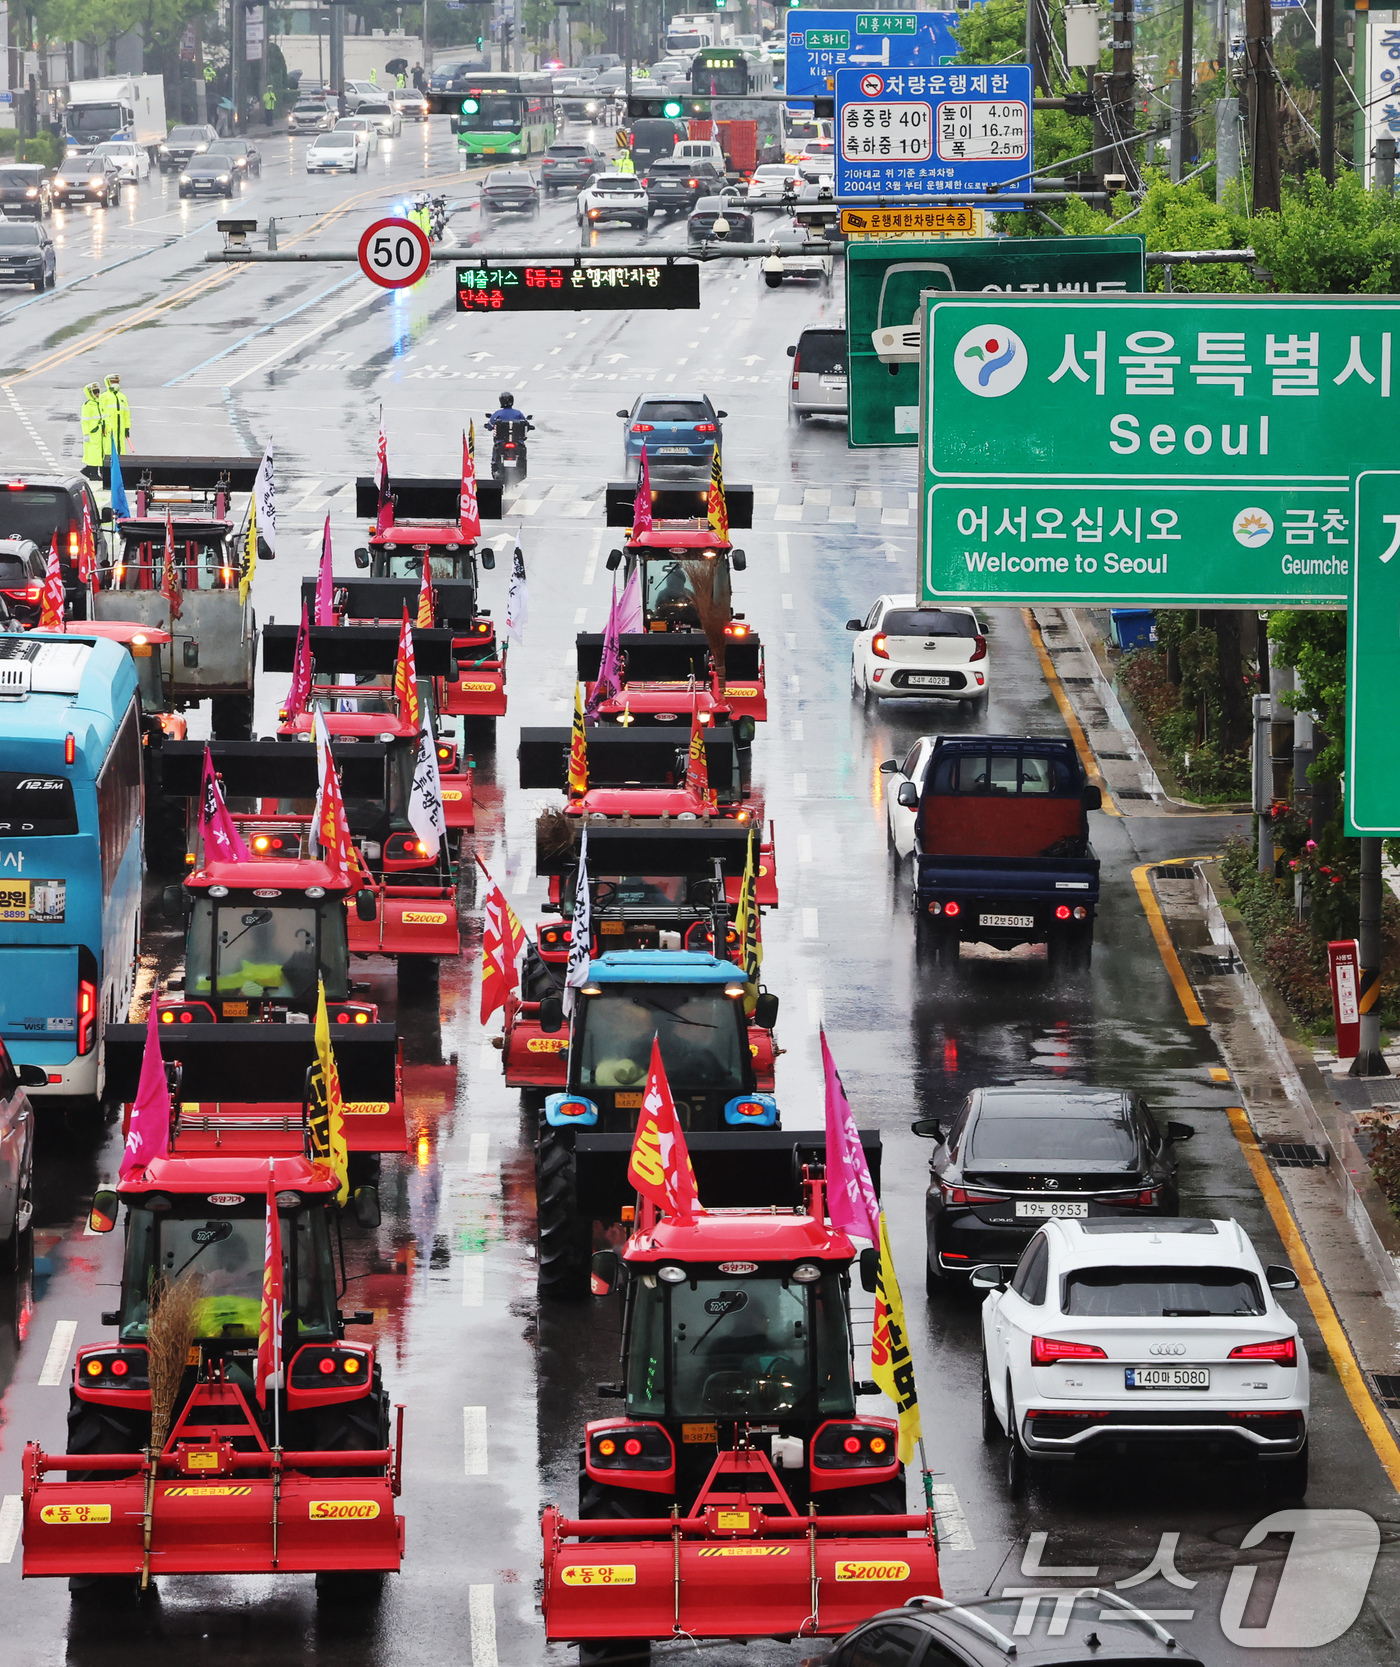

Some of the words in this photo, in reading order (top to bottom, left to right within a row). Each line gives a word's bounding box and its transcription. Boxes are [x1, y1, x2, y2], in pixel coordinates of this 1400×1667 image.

[858, 16, 916, 33] 시흥사거리
[809, 33, 847, 46] 소하IC
[807, 52, 848, 65] 기아로
[885, 73, 1010, 95] 차량운행제한
[846, 108, 893, 129] 총중량
[899, 111, 928, 128] 40t
[942, 104, 973, 121] 높이
[988, 105, 1023, 118] 4.0m
[942, 123, 973, 140] 길이
[981, 123, 1023, 137] 16.7m
[846, 136, 893, 155] 축하중
[899, 138, 928, 154] 10t
[951, 141, 967, 158] 폭
[990, 140, 1024, 155] 2.5m
[843, 169, 881, 179] 기아대교
[884, 168, 895, 179] 위
[897, 168, 916, 178] 기준
[918, 168, 956, 178] 초과차량
[843, 181, 882, 192] 2004년
[885, 181, 901, 191] 3월
[904, 181, 923, 191] 부터
[925, 180, 963, 191] 운행제한
[870, 213, 967, 228] 운행제한차량단속중
[372, 236, 416, 268] 50
[458, 269, 519, 288] 배출가스
[524, 267, 564, 288] 5등급
[570, 267, 661, 288] 운행제한차량
[458, 289, 505, 308] 단속중
[1047, 330, 1392, 398] 서울특별시
[1109, 413, 1270, 457] Seoul
[956, 506, 1182, 544] 어서오십시오
[964, 551, 1071, 574] Welcome
[1075, 553, 1099, 574] to
[1103, 552, 1169, 574] Seoul
[1281, 554, 1350, 577] Geumche
[927, 677, 947, 685] 4028
[25, 781, 64, 790] 12.5M
[0, 850, 25, 873] 사
[1007, 916, 1031, 927] 5013
[24, 1023, 46, 1031] WISE
[1023, 1204, 1046, 1215] 19누
[1051, 1204, 1082, 1216] 8953
[1136, 1370, 1170, 1384] 140마
[1173, 1370, 1207, 1384] 5080
[56, 1505, 92, 1522] 동양
[314, 1501, 376, 1519] S200CF
[726, 1547, 764, 1556] 접근금지
[578, 1567, 615, 1584] 동양
[841, 1562, 907, 1580] S200CF
